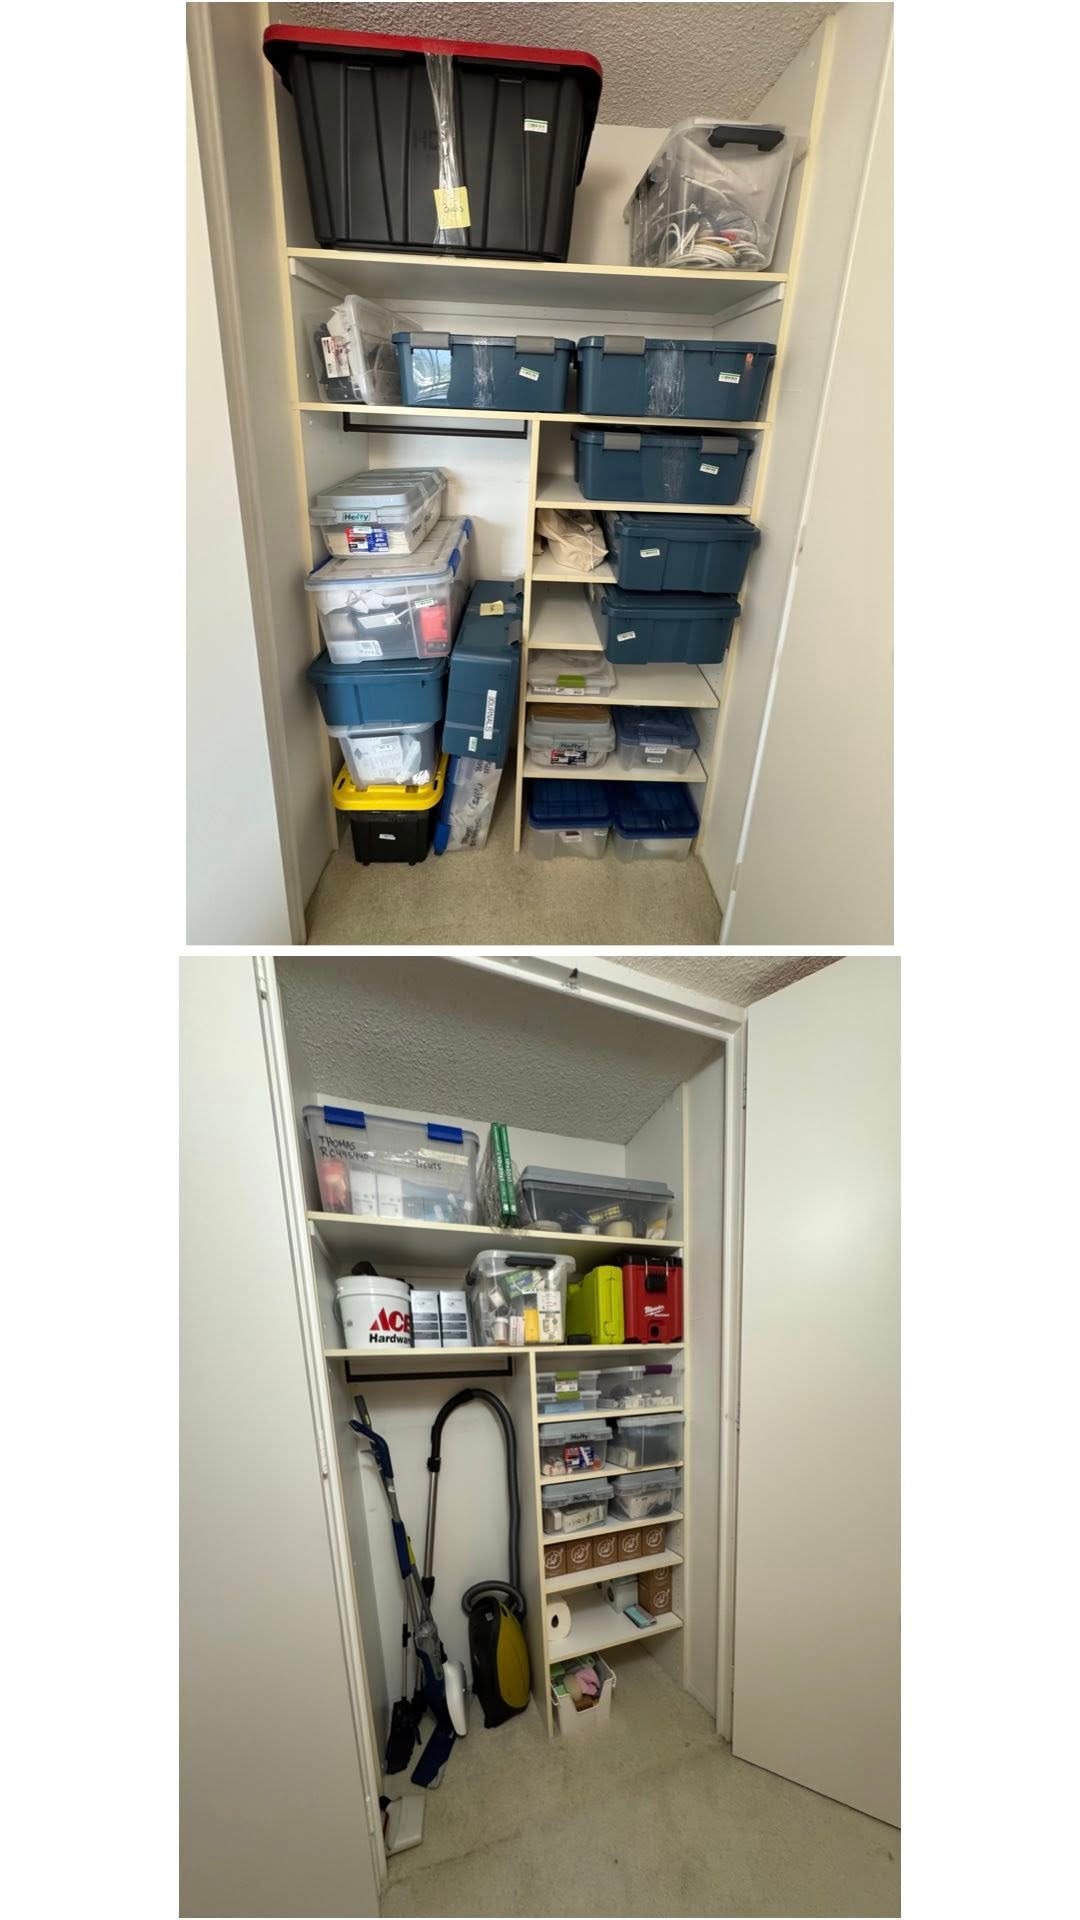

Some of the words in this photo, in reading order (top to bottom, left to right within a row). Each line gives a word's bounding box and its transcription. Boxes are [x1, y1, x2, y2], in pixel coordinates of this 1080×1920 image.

[344, 512, 369, 521] Hefty
[318, 1135, 356, 1151] THOMAS
[369, 1306, 411, 1333] ACE
